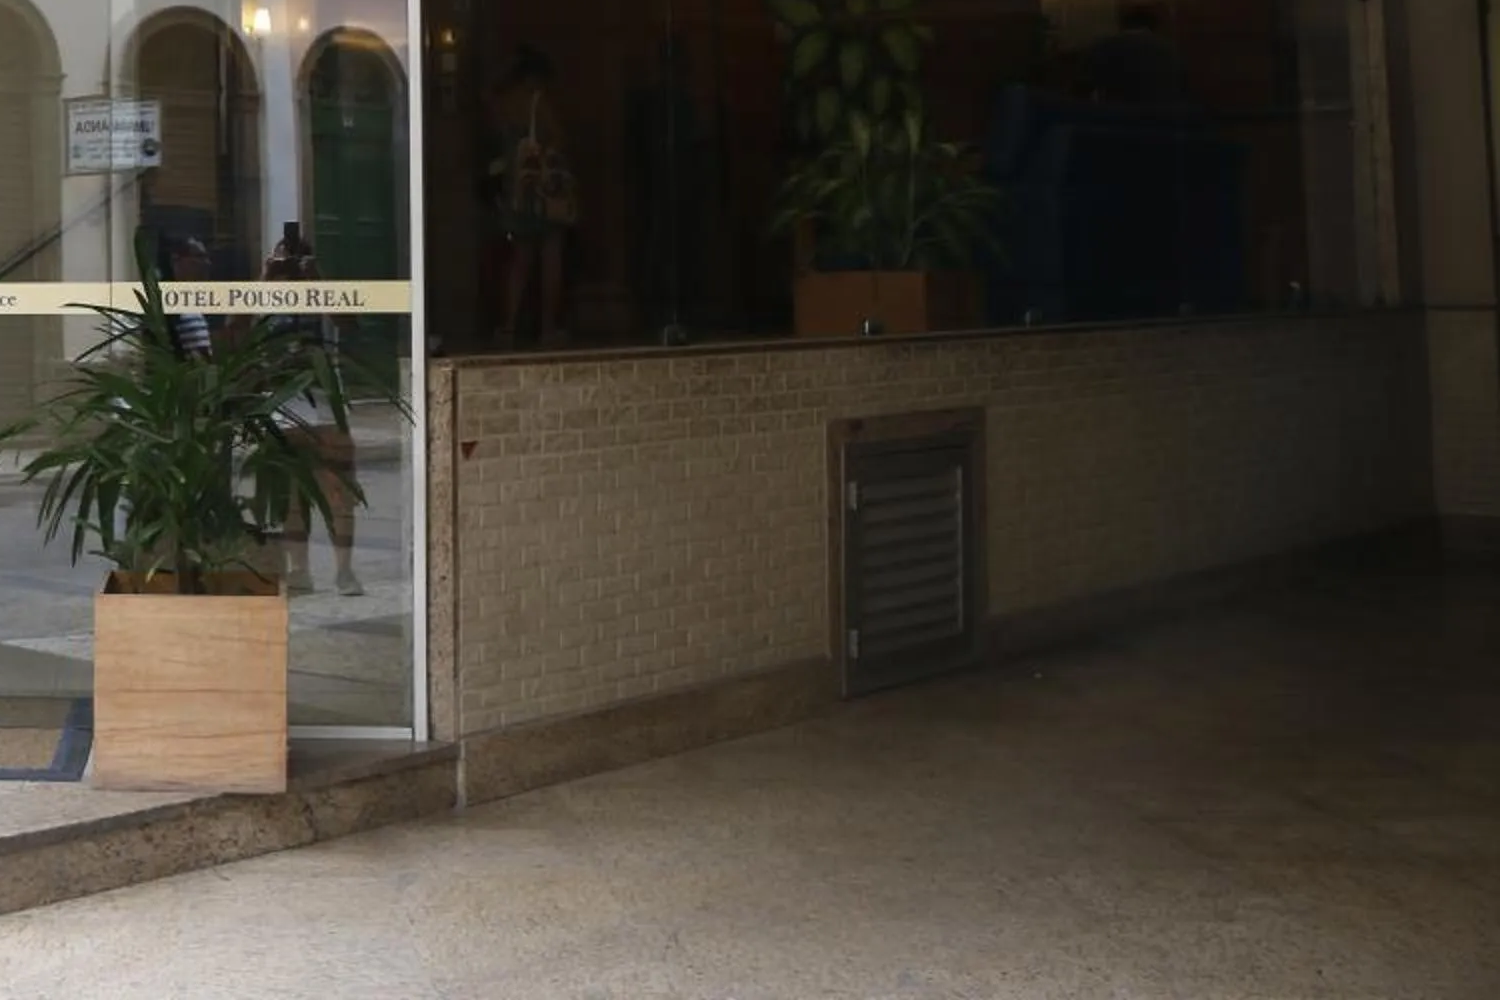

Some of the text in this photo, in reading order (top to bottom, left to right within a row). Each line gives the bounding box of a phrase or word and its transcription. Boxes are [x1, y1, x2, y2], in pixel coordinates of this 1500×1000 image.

[160, 287, 366, 308] OTEL POUSO REAL
